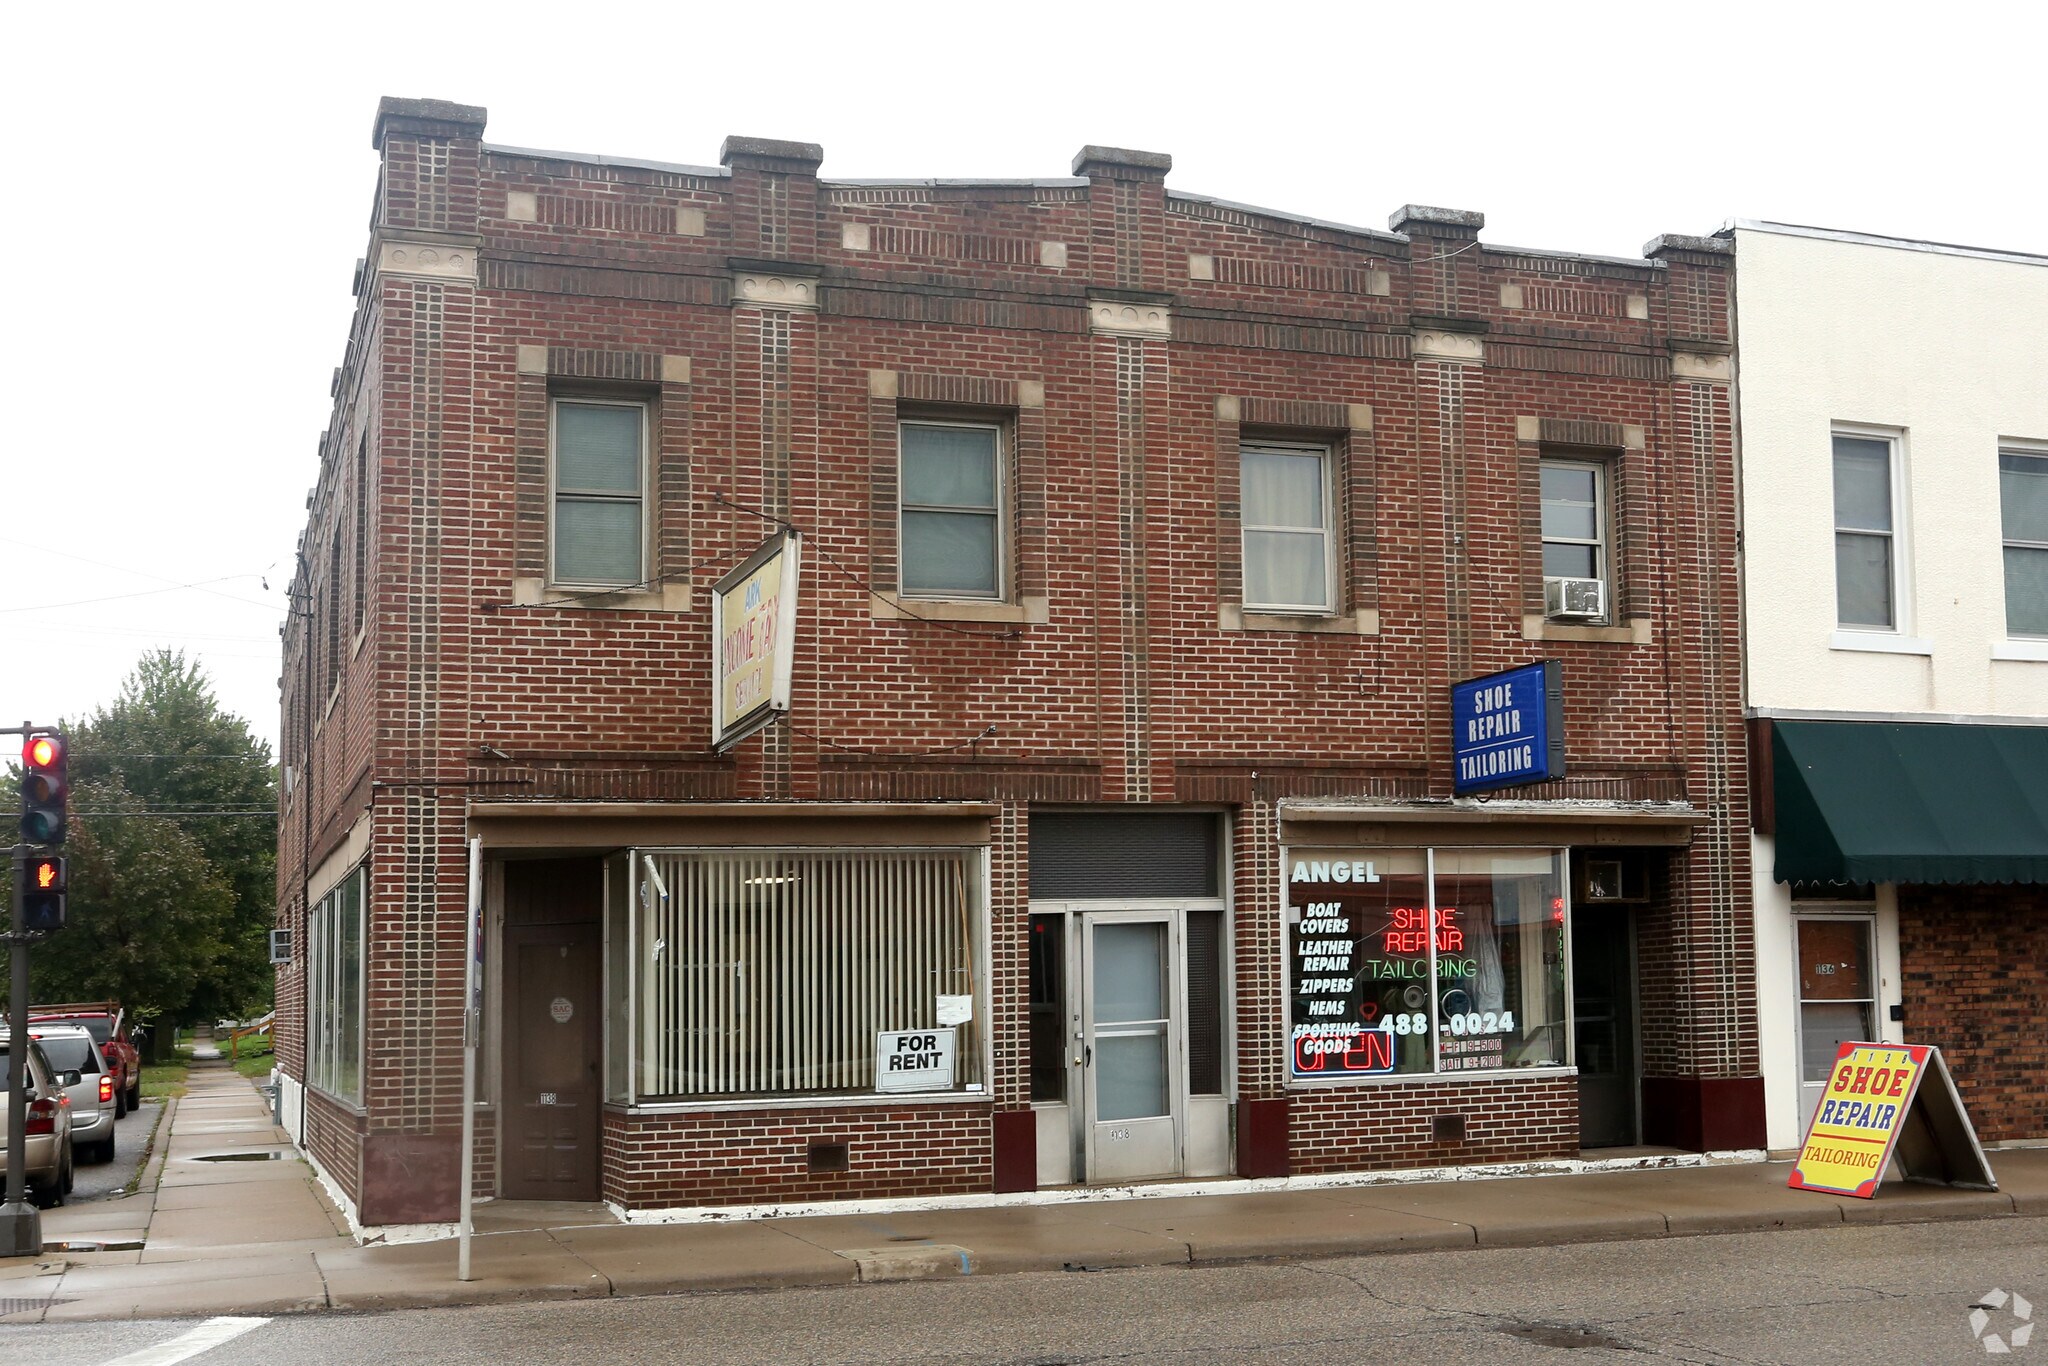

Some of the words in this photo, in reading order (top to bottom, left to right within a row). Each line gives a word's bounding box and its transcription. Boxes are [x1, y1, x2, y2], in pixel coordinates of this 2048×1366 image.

[724, 616, 755, 678] INCOME
[1475, 683, 1512, 714] SHOE
[1468, 710, 1521, 743] REPAIR
[1461, 745, 1532, 780] TAILORING
[1291, 861, 1380, 883] ANGEL
[1306, 902, 1342, 918] BOAT
[1300, 918, 1349, 934] COVERS
[1298, 940, 1354, 956] LEATHER
[1303, 956, 1350, 972] REPAIR
[1816, 963, 1834, 974] 1136
[1299, 978, 1354, 994] ZIPPERS
[1308, 1000, 1346, 1015] HEMS
[1294, 1022, 1361, 1039] SPORTING
[897, 1035, 936, 1053] FOR
[1296, 1032, 1390, 1071] OPEN
[1304, 1039, 1352, 1055] GOODS
[889, 1052, 942, 1071] RENT
[1440, 1058, 1460, 1070] SAT
[1833, 1065, 1910, 1097] SHOE
[1819, 1099, 1897, 1130] REPAIR
[1804, 1145, 1880, 1169] TAILORING
